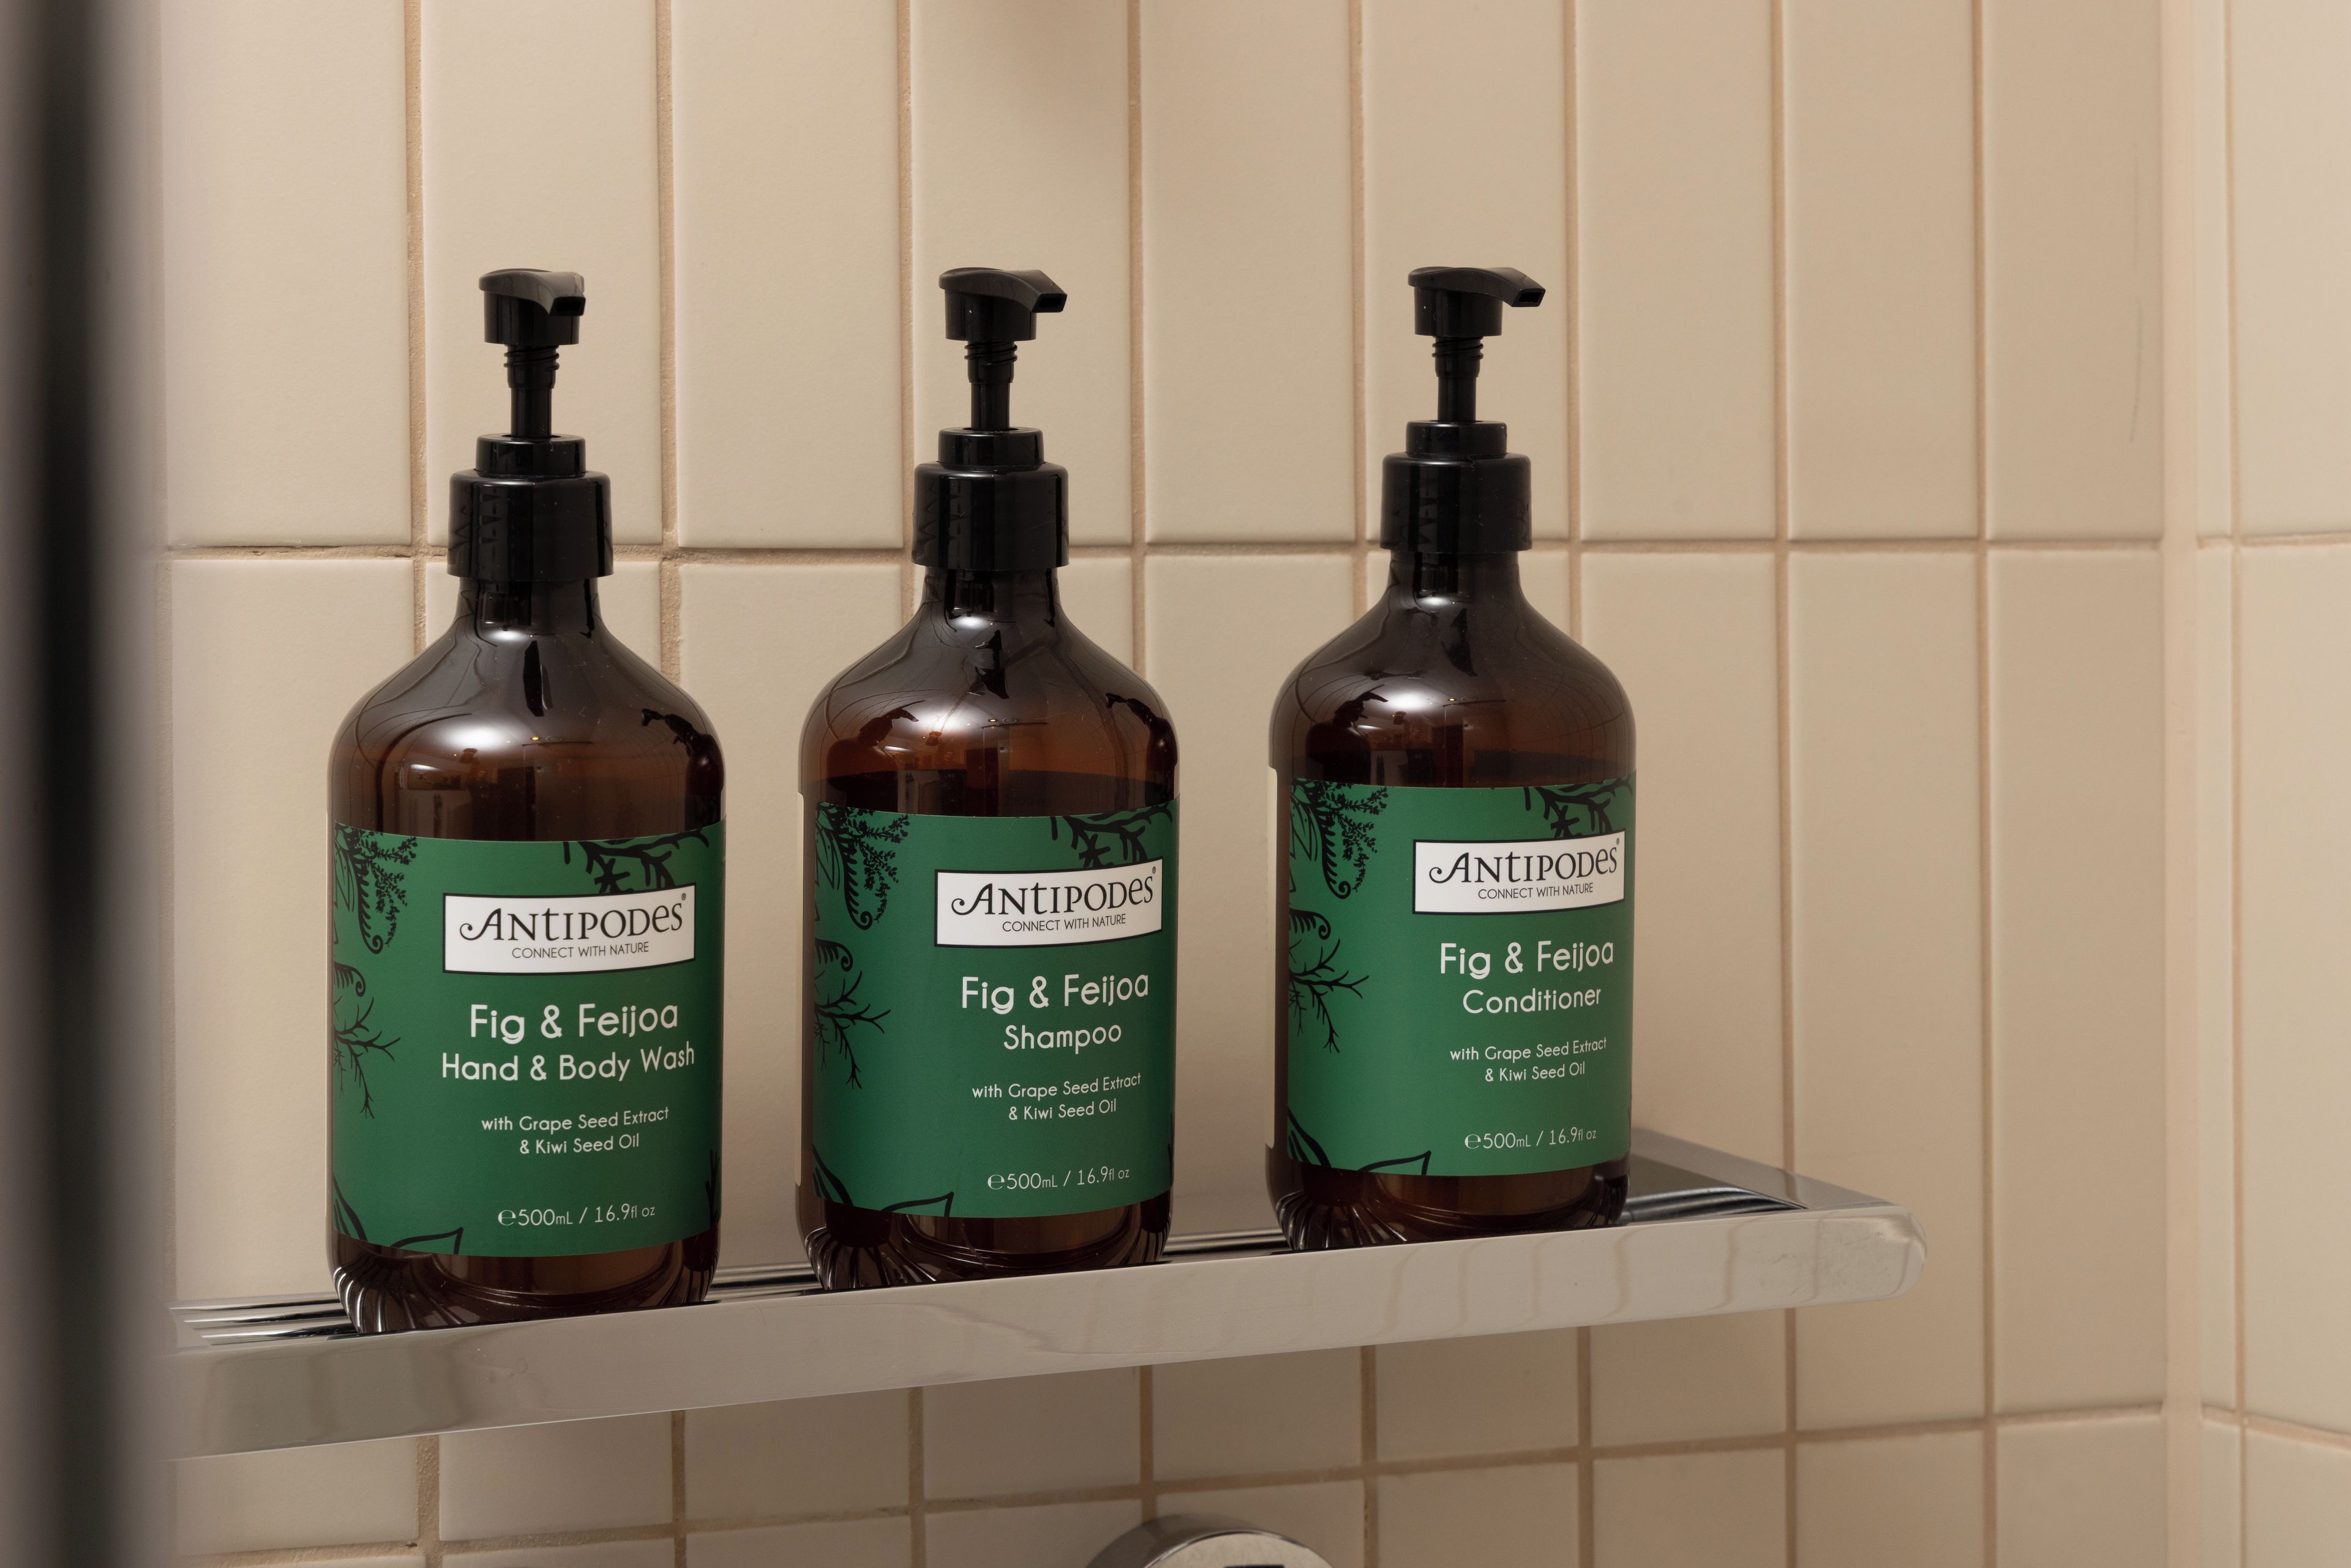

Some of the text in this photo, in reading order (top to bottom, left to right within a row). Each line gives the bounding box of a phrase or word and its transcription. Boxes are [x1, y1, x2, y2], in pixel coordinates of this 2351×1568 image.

[1478, 882, 1594, 899] CONNECT WITH NATURE
[1002, 913, 1126, 932] CONNECT WITH NATURE
[512, 941, 649, 959] CONNECT WITH NATURE
[1440, 940, 1613, 980] Fig & Feijoa
[962, 973, 1149, 1015] Fig & Feijoa
[1463, 988, 1601, 1014] Conditioner
[470, 1003, 678, 1044] Fig & Feijoa
[1003, 1024, 1122, 1055] Shampoo
[1450, 1037, 1607, 1063] with Grape Seed Extract
[442, 1041, 694, 1082] Hand & Body Wash
[1485, 1060, 1585, 1082] & Kiwi Seed Oil
[972, 1072, 1141, 1101] with Grape Seed Extract
[481, 1106, 669, 1135] with Grape Seed Extract
[1008, 1098, 1116, 1120] & Kiwi Seed Oil
[519, 1133, 639, 1154] & Kiwi Seed Oil
[1535, 1130, 1543, 1146] /
[1586, 1130, 1597, 1140] oz
[1063, 1170, 1071, 1187] /
[1118, 1169, 1130, 1179] oz
[579, 1207, 588, 1224] /
[641, 1207, 655, 1217] oz
